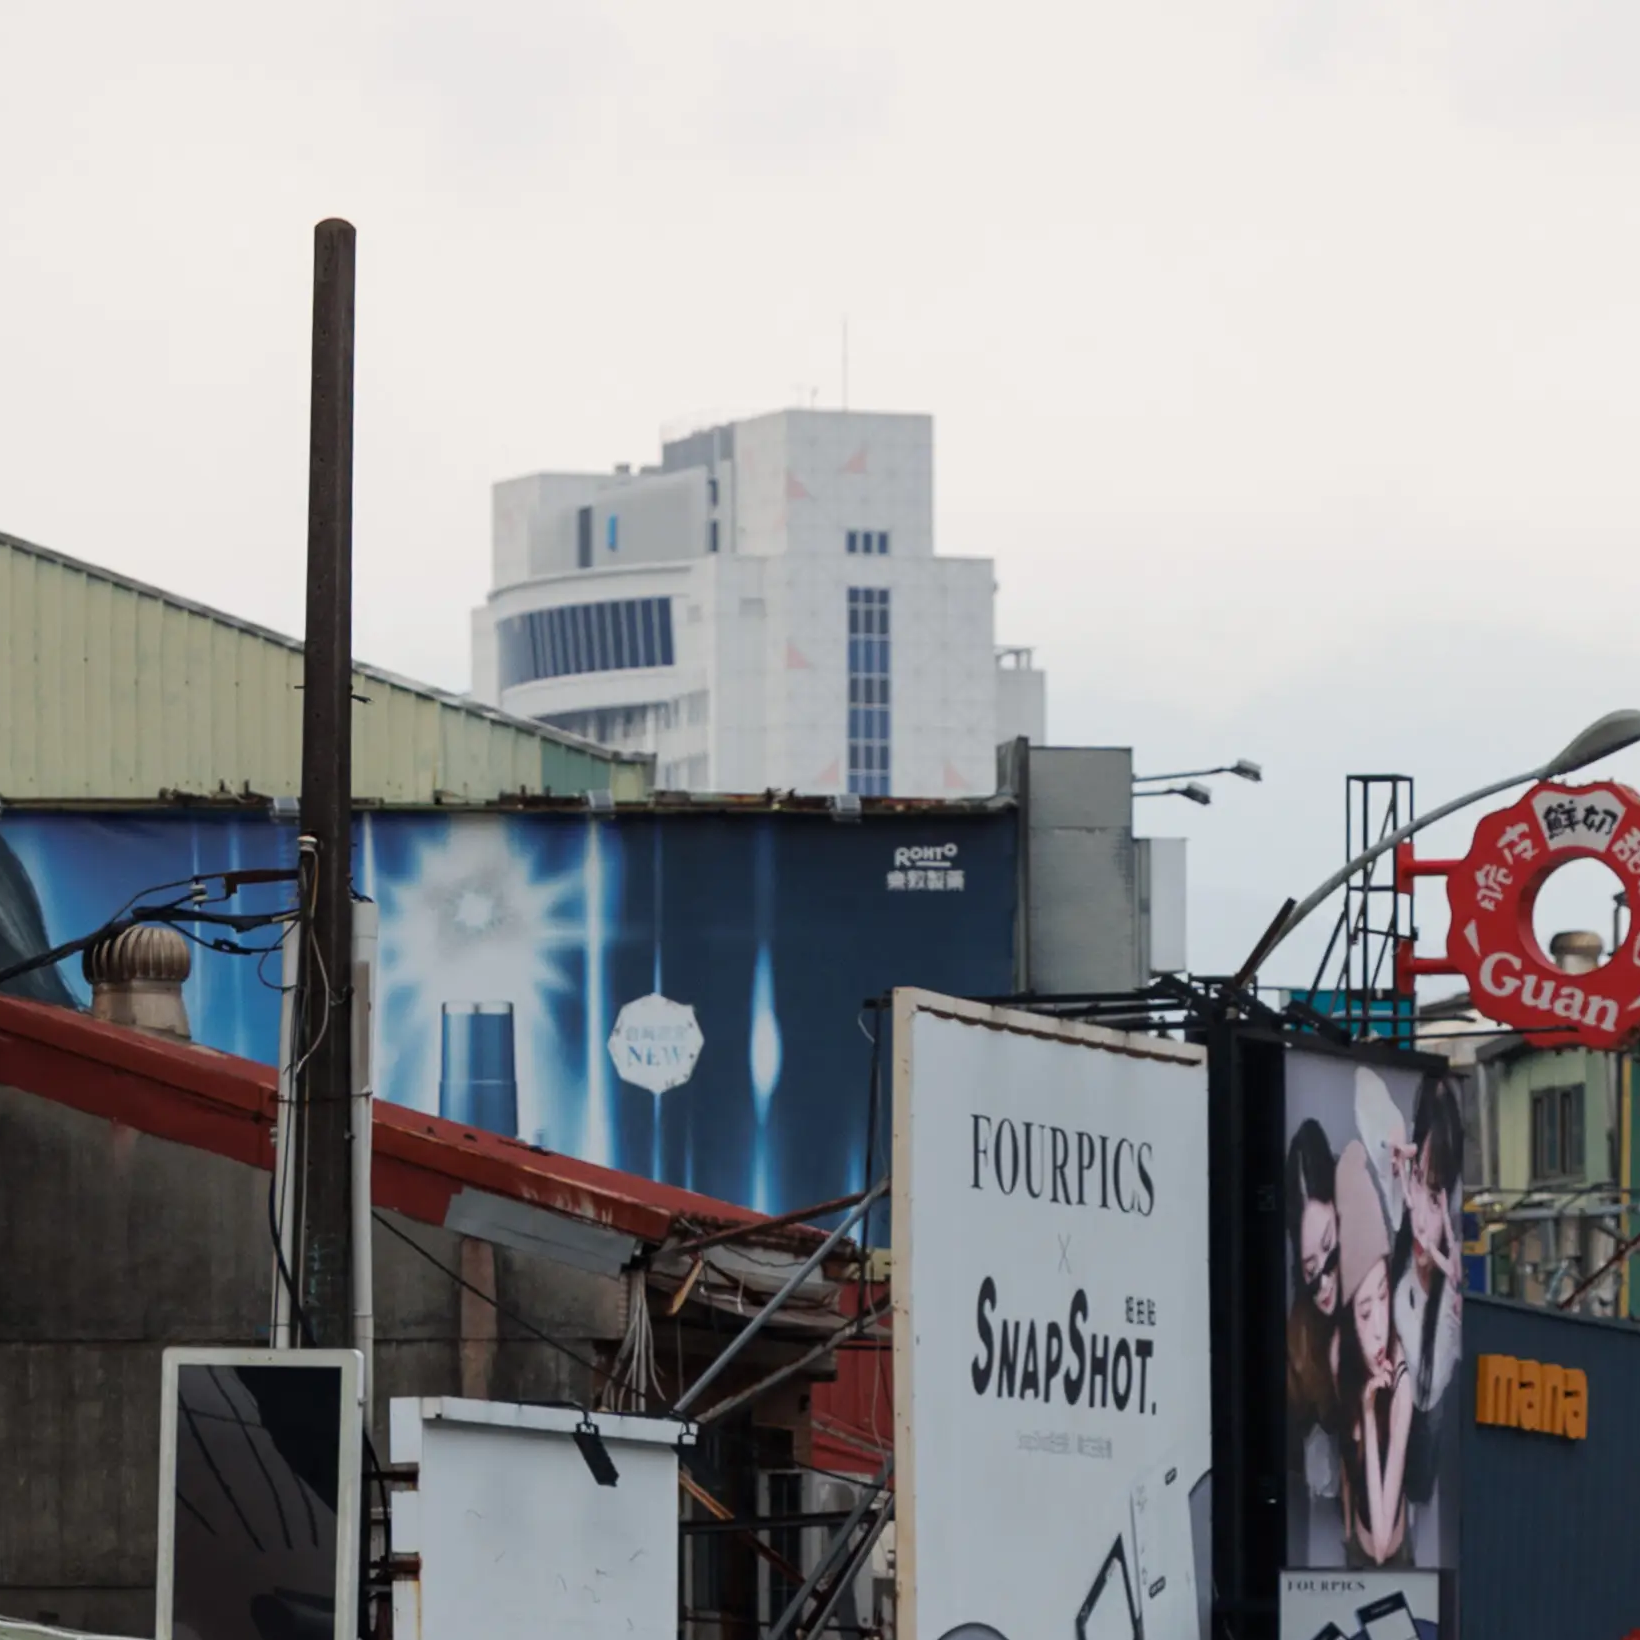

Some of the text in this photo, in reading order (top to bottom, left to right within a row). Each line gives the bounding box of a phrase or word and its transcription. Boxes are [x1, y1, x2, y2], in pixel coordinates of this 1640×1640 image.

[894, 843, 958, 868] ROHTO
[1479, 951, 1620, 1032] Guan
[970, 1113, 1155, 1217] FOURPICS
[1287, 1580, 1366, 1592] FOURPICS
